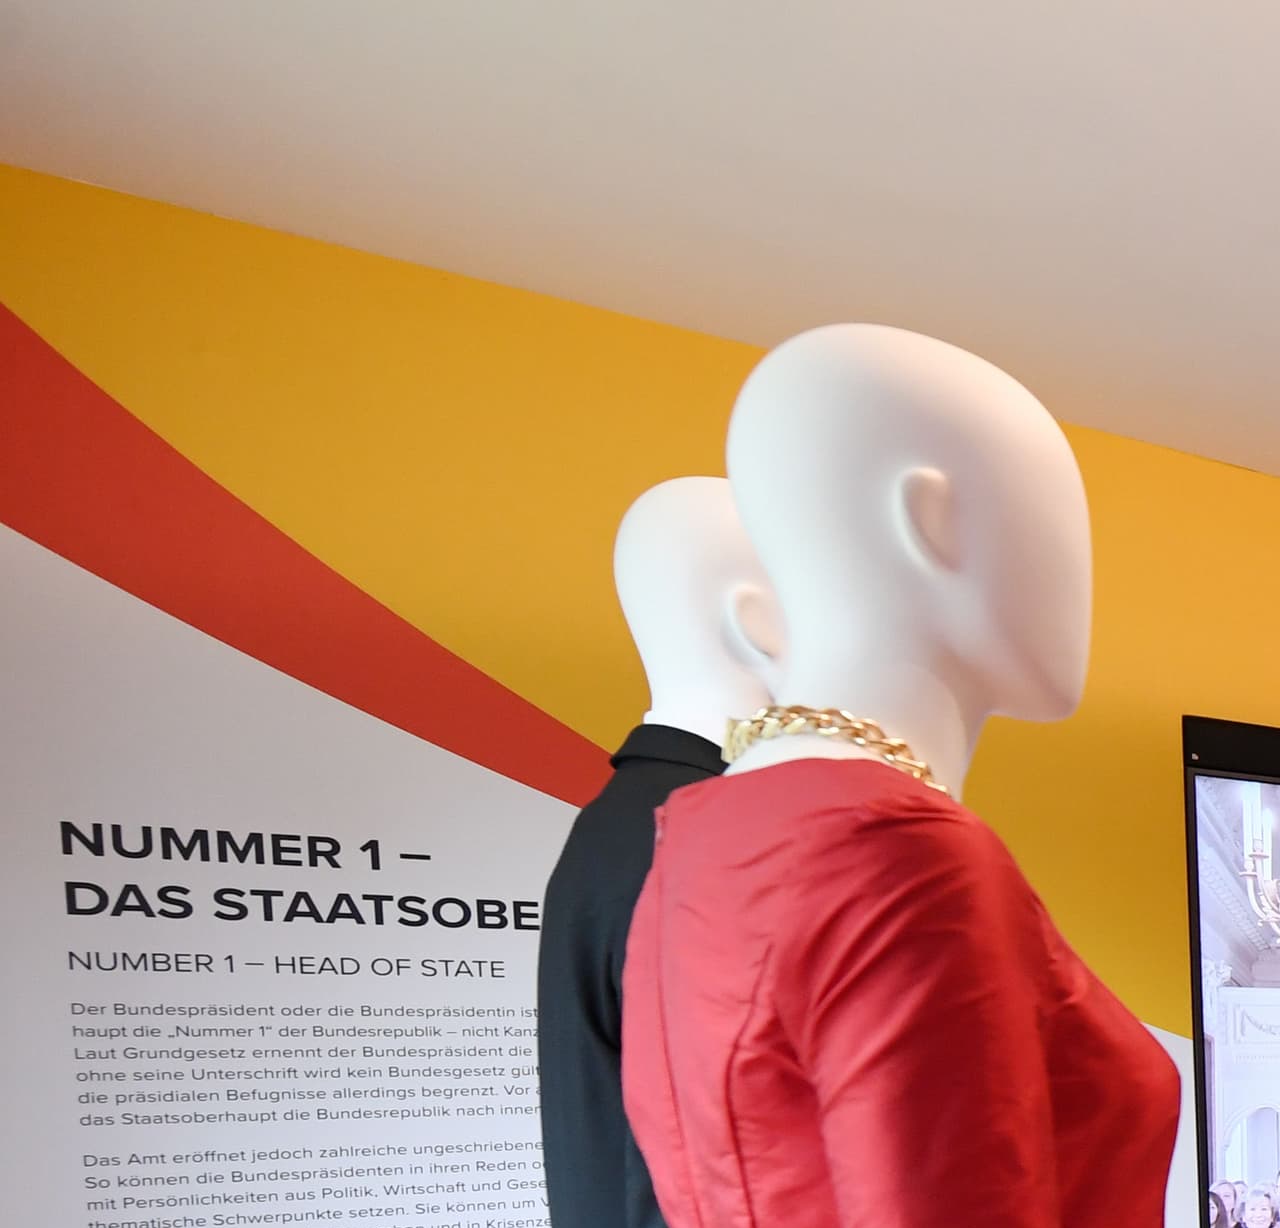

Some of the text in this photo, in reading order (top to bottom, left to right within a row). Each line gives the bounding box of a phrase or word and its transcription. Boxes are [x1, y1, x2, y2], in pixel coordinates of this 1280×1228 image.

[60, 821, 380, 870] NUMMER 1
[65, 881, 540, 930] DAS STAATSOBE
[68, 951, 505, 978] NUMBER 1 HEAD OF STATE
[70, 1002, 107, 1016] Der
[113, 1003, 276, 1019] Bundespräsident
[280, 1004, 322, 1016] oder
[327, 1005, 355, 1017] die
[360, 1005, 516, 1020] Bundespräsidentin
[72, 1025, 128, 1040] haupt
[132, 1025, 162, 1038] die
[278, 1026, 308, 1038] der
[312, 1025, 442, 1040] Bundesrepublik
[462, 1026, 500, 1038] nicht
[74, 1046, 532, 1062] Laut Grundgesetz ernennt der Bundespräsident die
[76, 1070, 127, 1082] ohne
[132, 1069, 185, 1082] seine
[191, 1067, 299, 1080] Unterschrift
[303, 1067, 341, 1079] wird
[347, 1066, 382, 1078] kein
[388, 1066, 506, 1080] Bundesgesetz
[78, 1092, 109, 1104] die
[115, 1090, 220, 1106] präsidialen
[226, 1088, 327, 1104] Befugnisse
[332, 1086, 416, 1101] allerdings
[503, 1084, 531, 1096] Vor
[80, 1104, 495, 1126] das Staatsoberhaupt die Bundesrepublik nach
[82, 1154, 121, 1168] Das
[127, 1153, 167, 1166] Amt
[172, 1150, 247, 1164] eröffnet
[250, 1147, 313, 1164] jedoch
[319, 1144, 408, 1158] zahlreiche
[84, 1160, 526, 1190] So können die Bundespräsidenten in ihren Reden
[87, 1198, 118, 1211] mit
[122, 1192, 279, 1209] Persönlichkeiten
[284, 1191, 316, 1201] aus
[383, 1181, 466, 1196] Wirtschaft
[471, 1180, 502, 1192] und
[212, 1209, 343, 1226] Schwerpunkte
[415, 1202, 441, 1215] Sie
[446, 1201, 506, 1213] können
[512, 1200, 536, 1209] um
